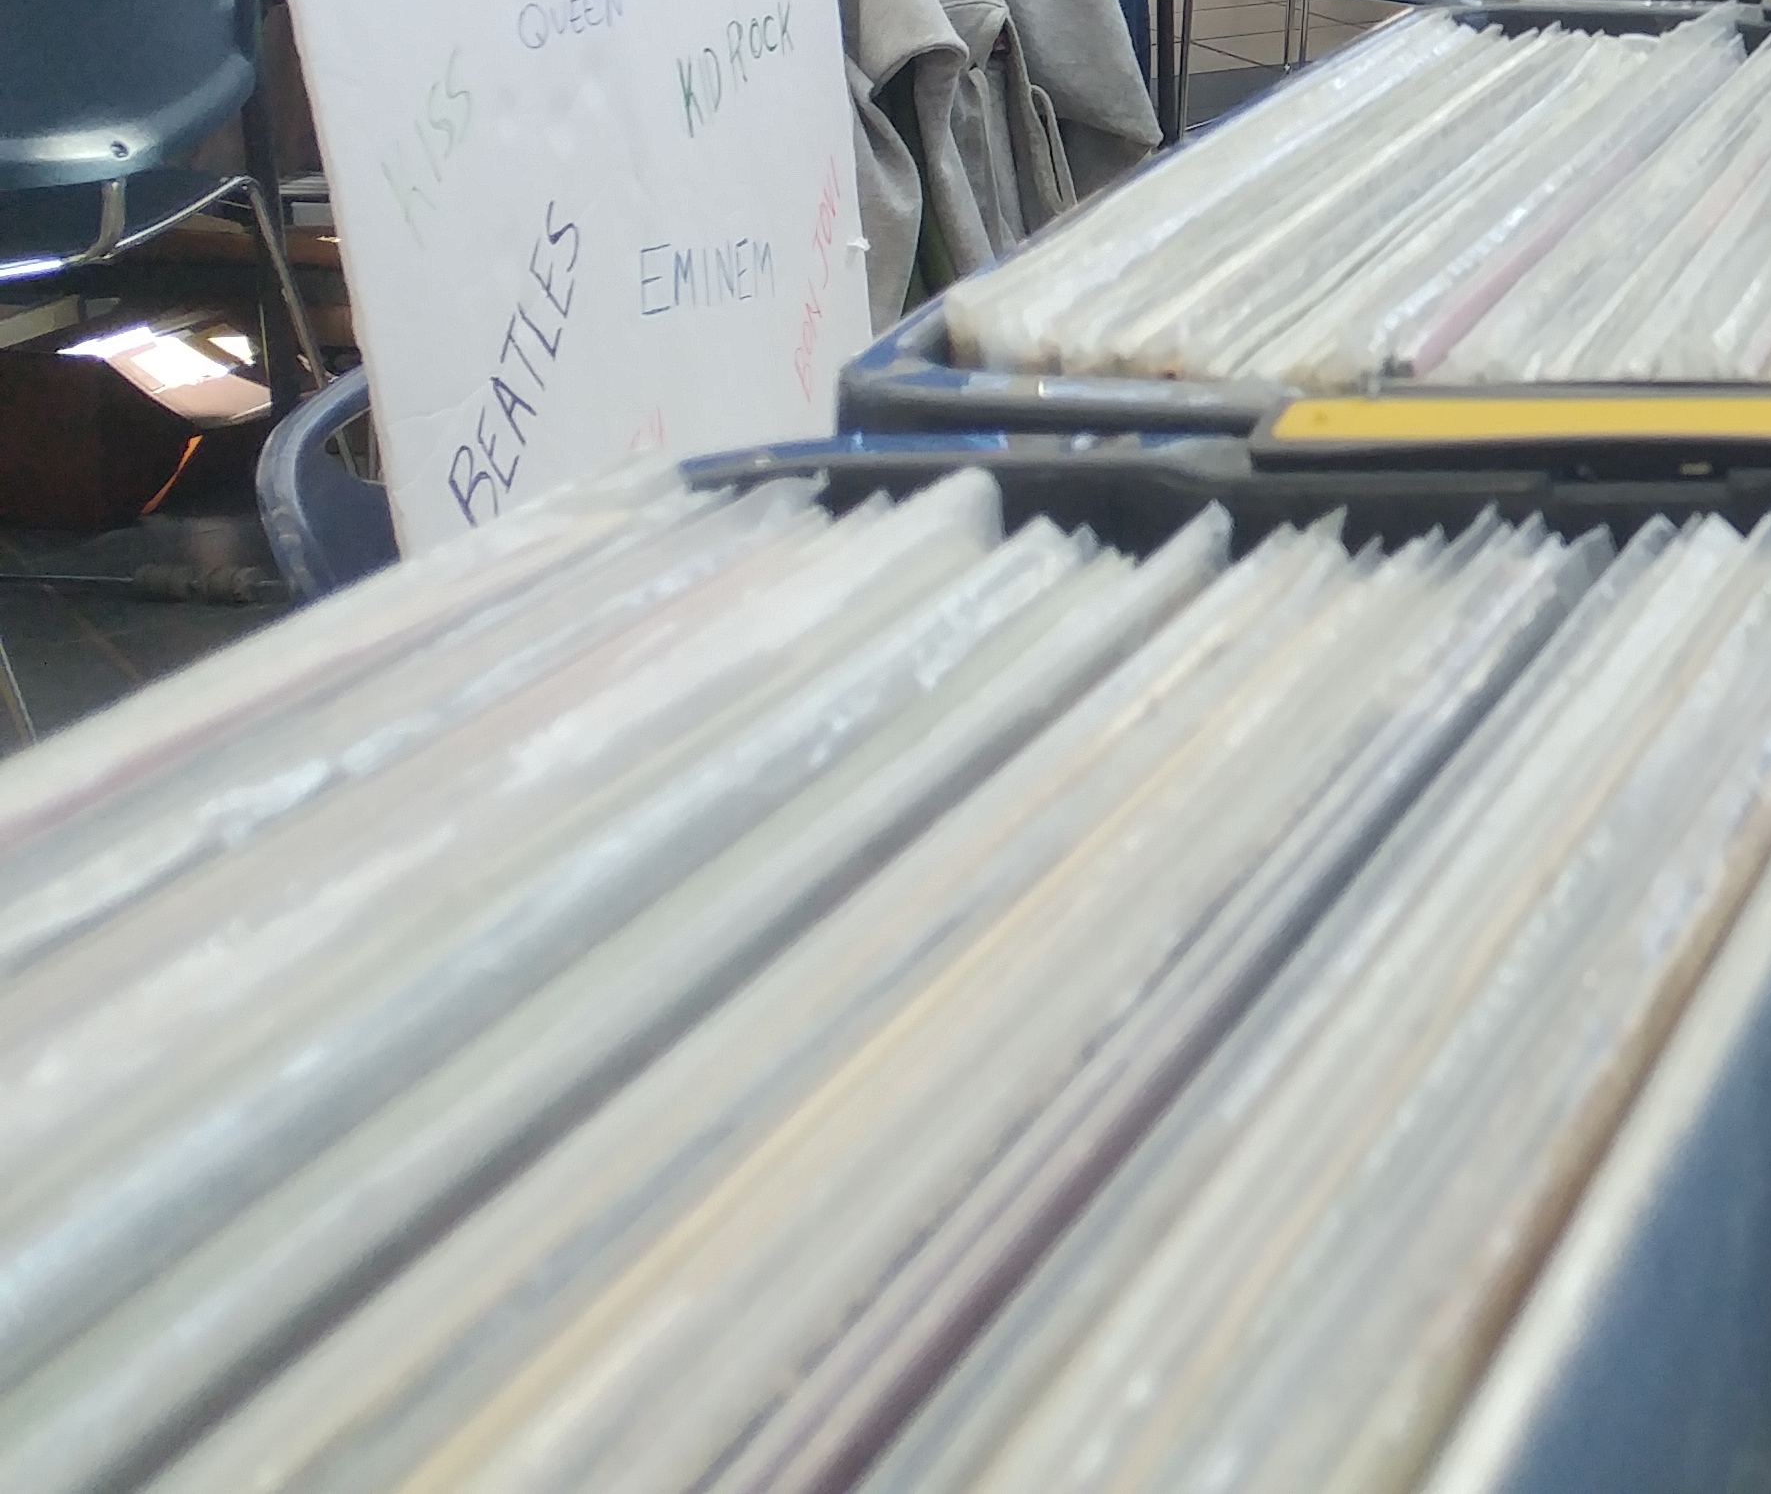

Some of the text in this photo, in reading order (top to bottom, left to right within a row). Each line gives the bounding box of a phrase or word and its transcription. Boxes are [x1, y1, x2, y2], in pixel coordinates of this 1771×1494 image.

[380, 45, 474, 249] KISS
[676, 0, 795, 139] KID ROCK
[640, 237, 776, 315] EMINEM
[447, 200, 581, 528] BEATLES
